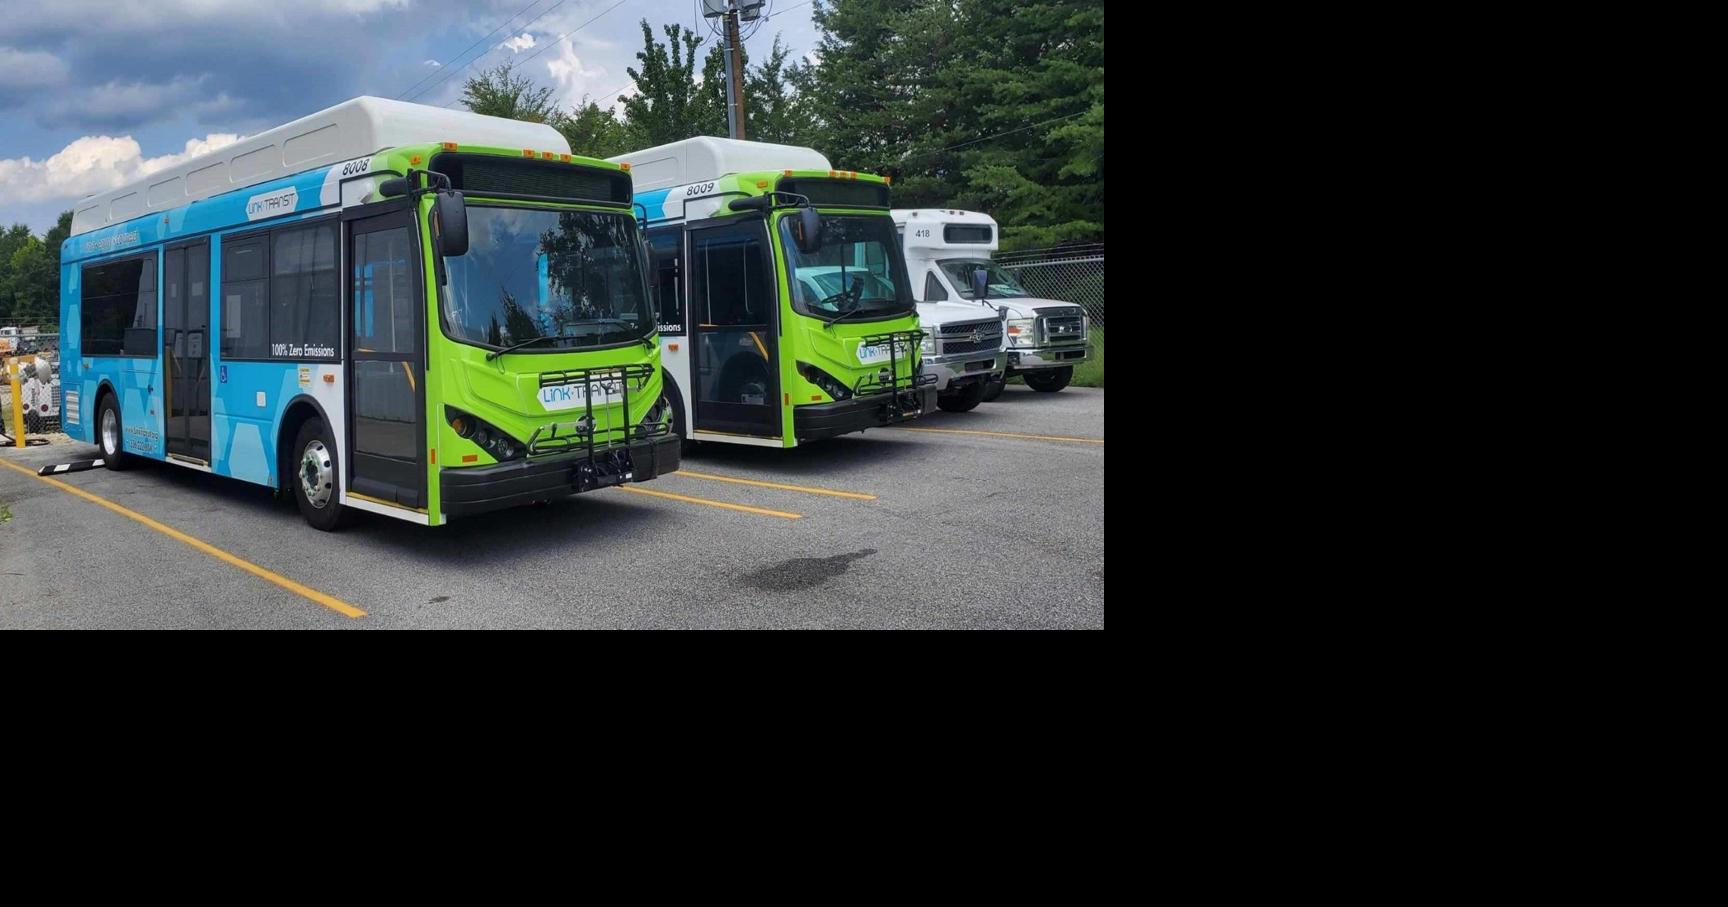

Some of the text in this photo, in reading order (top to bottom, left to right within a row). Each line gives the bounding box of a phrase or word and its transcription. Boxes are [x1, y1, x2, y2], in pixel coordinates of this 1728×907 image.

[342, 158, 370, 176] 8008
[686, 182, 715, 196] 8009
[915, 229, 931, 238] 418
[271, 343, 335, 357] 100% Zero Emissions
